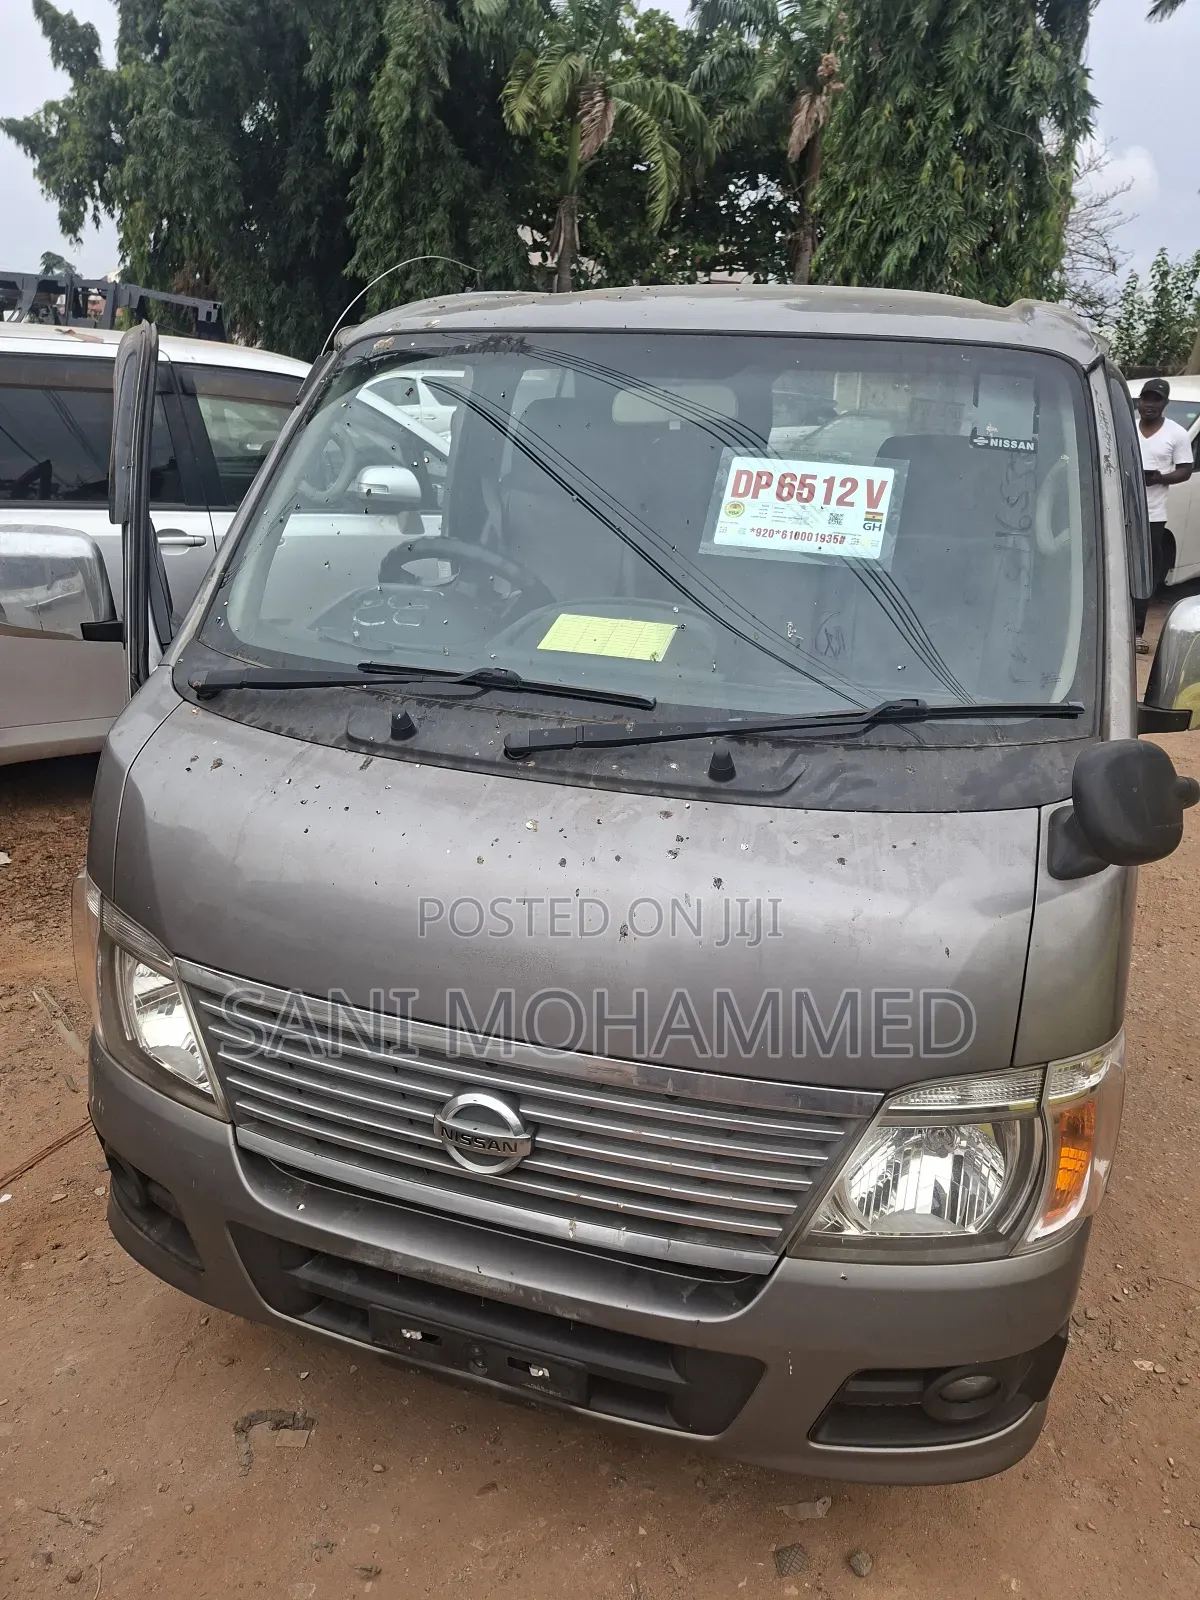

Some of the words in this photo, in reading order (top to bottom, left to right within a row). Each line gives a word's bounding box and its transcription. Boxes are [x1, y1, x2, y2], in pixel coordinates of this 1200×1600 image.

[989, 438, 1035, 450] NISSAN
[866, 479, 888, 509] V
[862, 522, 883, 532] GH
[440, 1126, 518, 1154] NISSAN
